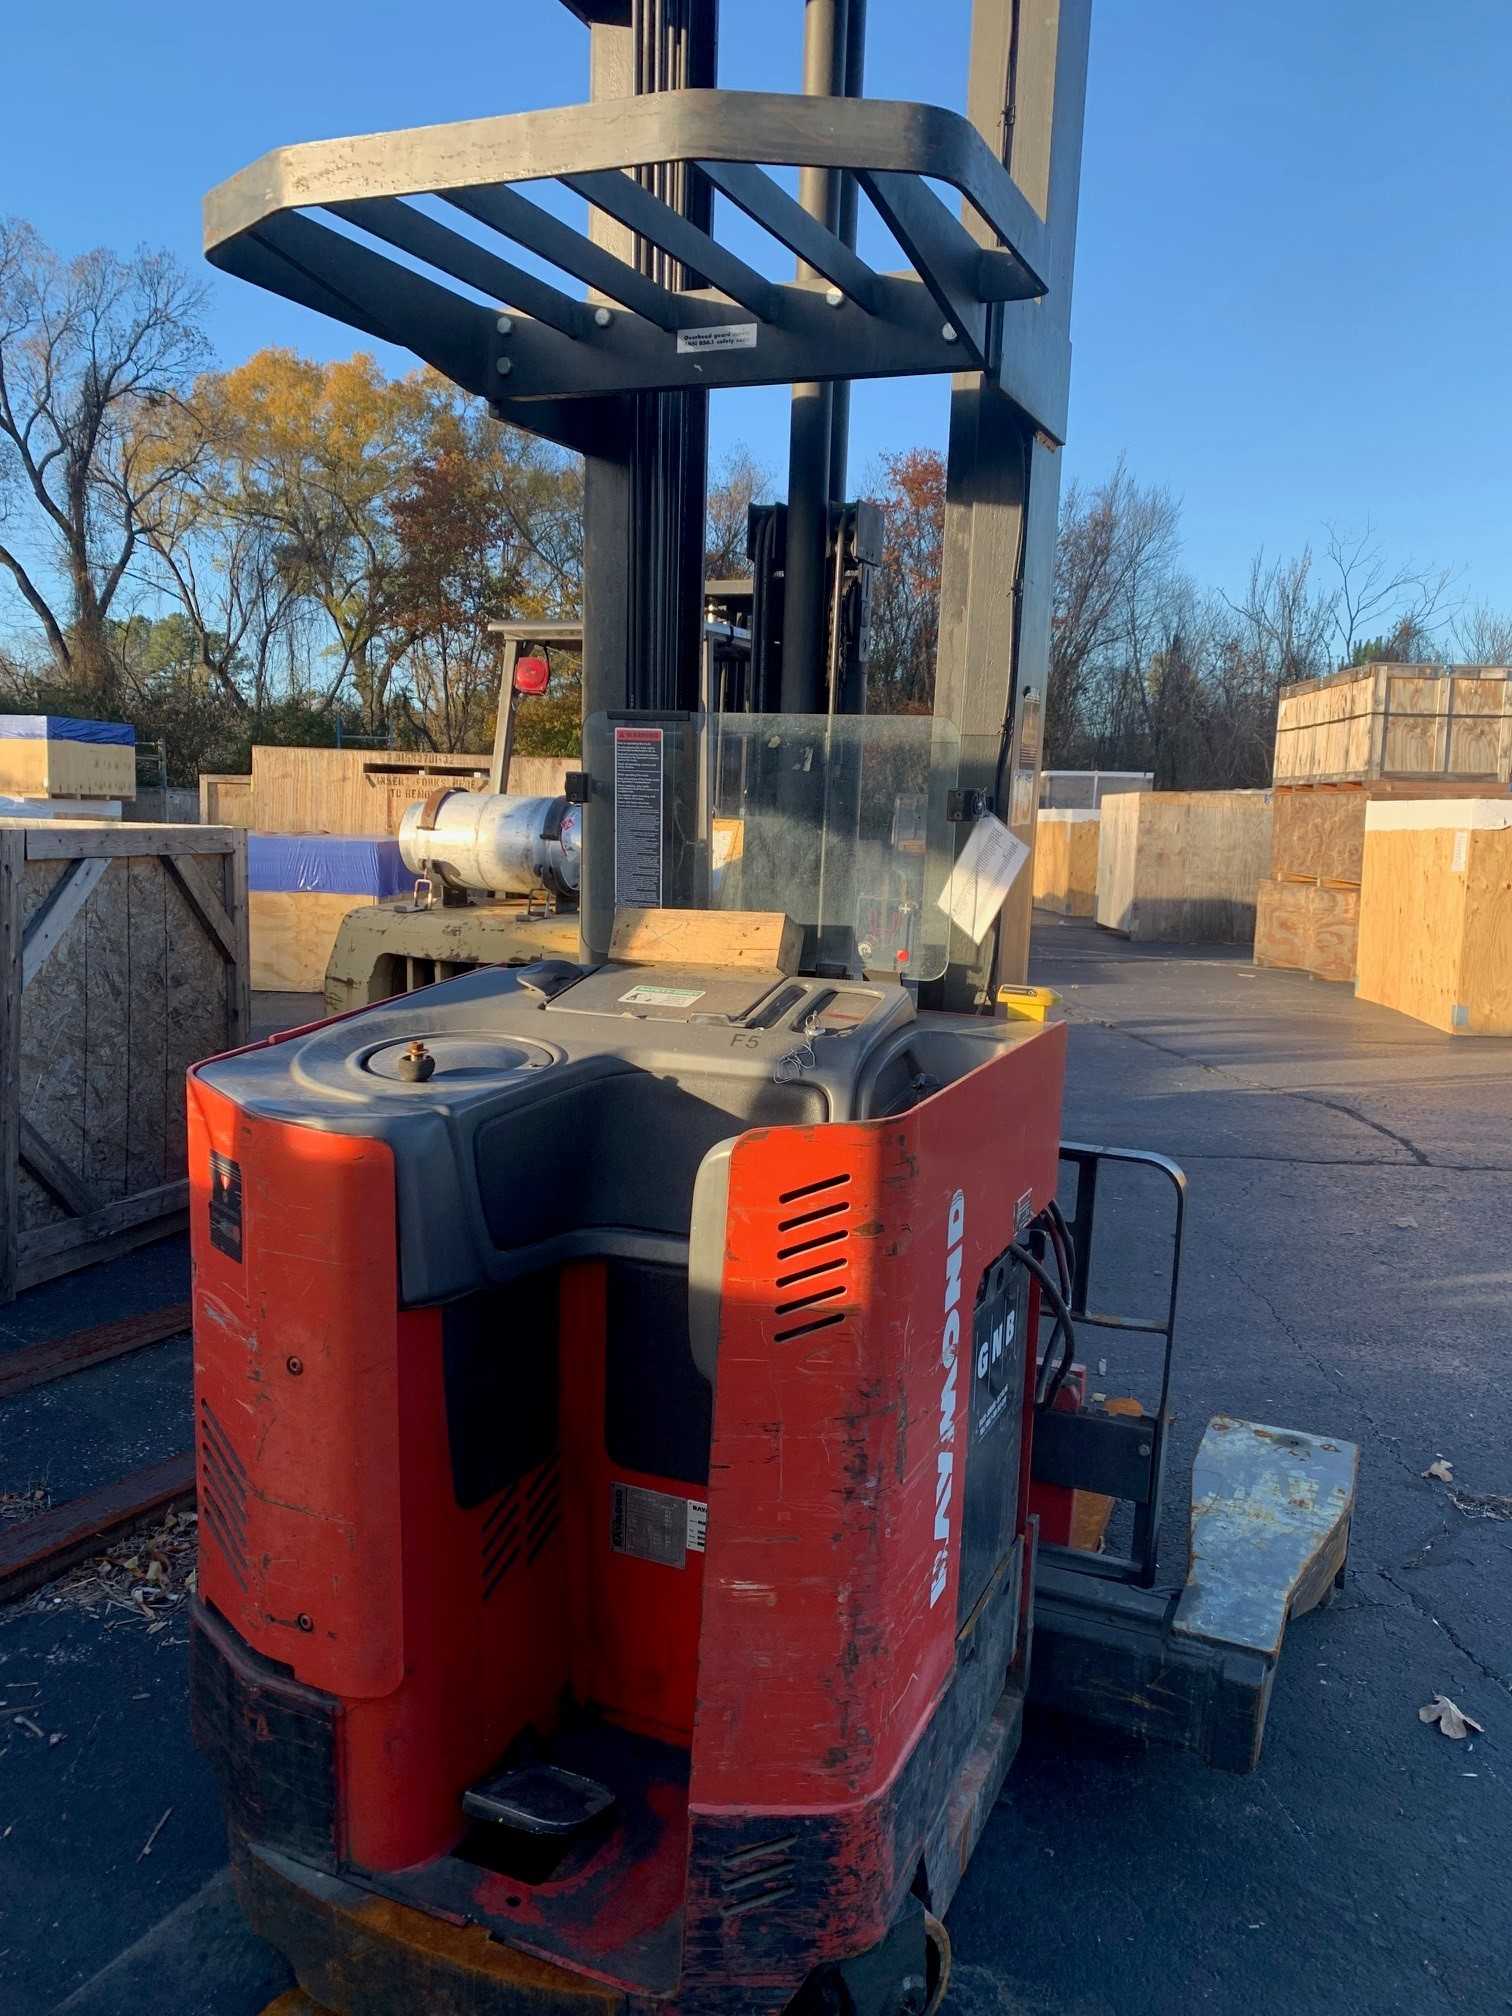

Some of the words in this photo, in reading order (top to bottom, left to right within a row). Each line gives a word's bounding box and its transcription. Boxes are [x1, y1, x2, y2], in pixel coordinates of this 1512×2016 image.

[405, 789, 431, 798] REMO
[730, 1034, 761, 1048] F5
[930, 1188, 965, 1609] RAYMOND
